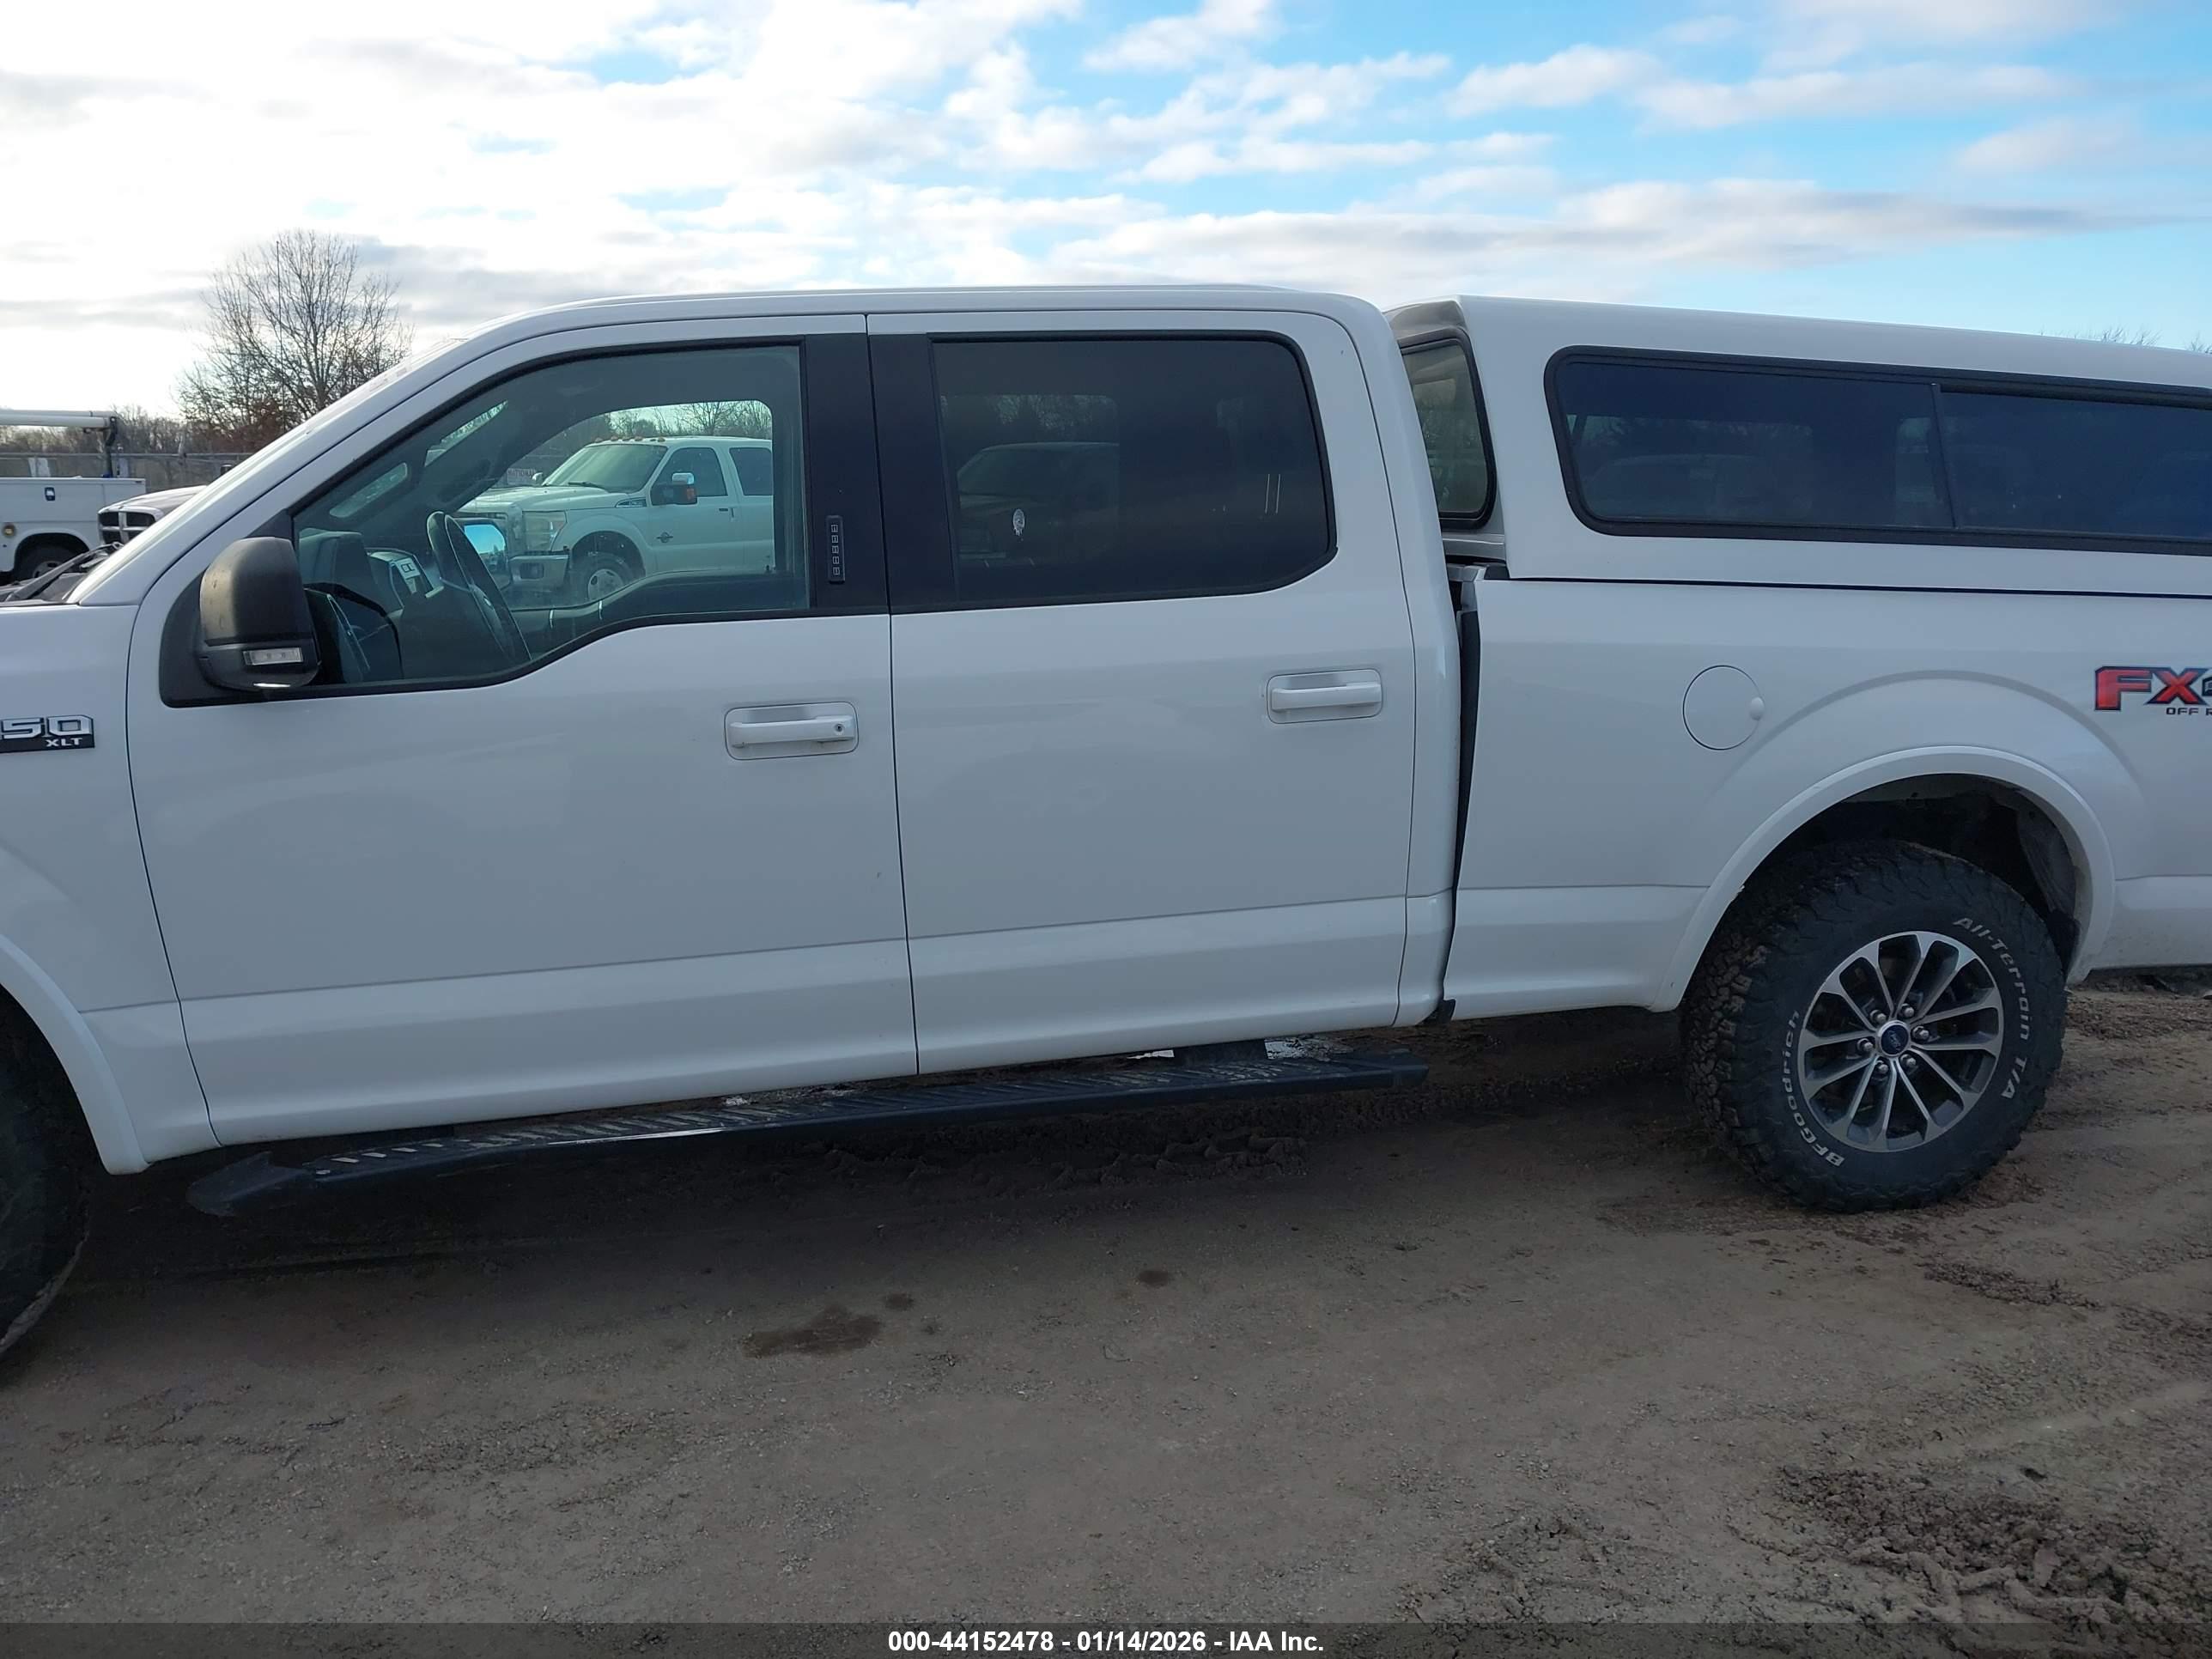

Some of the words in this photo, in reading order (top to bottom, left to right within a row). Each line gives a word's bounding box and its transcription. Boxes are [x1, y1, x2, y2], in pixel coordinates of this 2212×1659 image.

[46, 738, 83, 747] XLT
[2166, 707, 2199, 715] OFF
[1953, 917, 2033, 1041] All-Terrain
[2001, 1056, 2027, 1099] T/A
[1782, 1009, 1845, 1167] BFGoodrich
